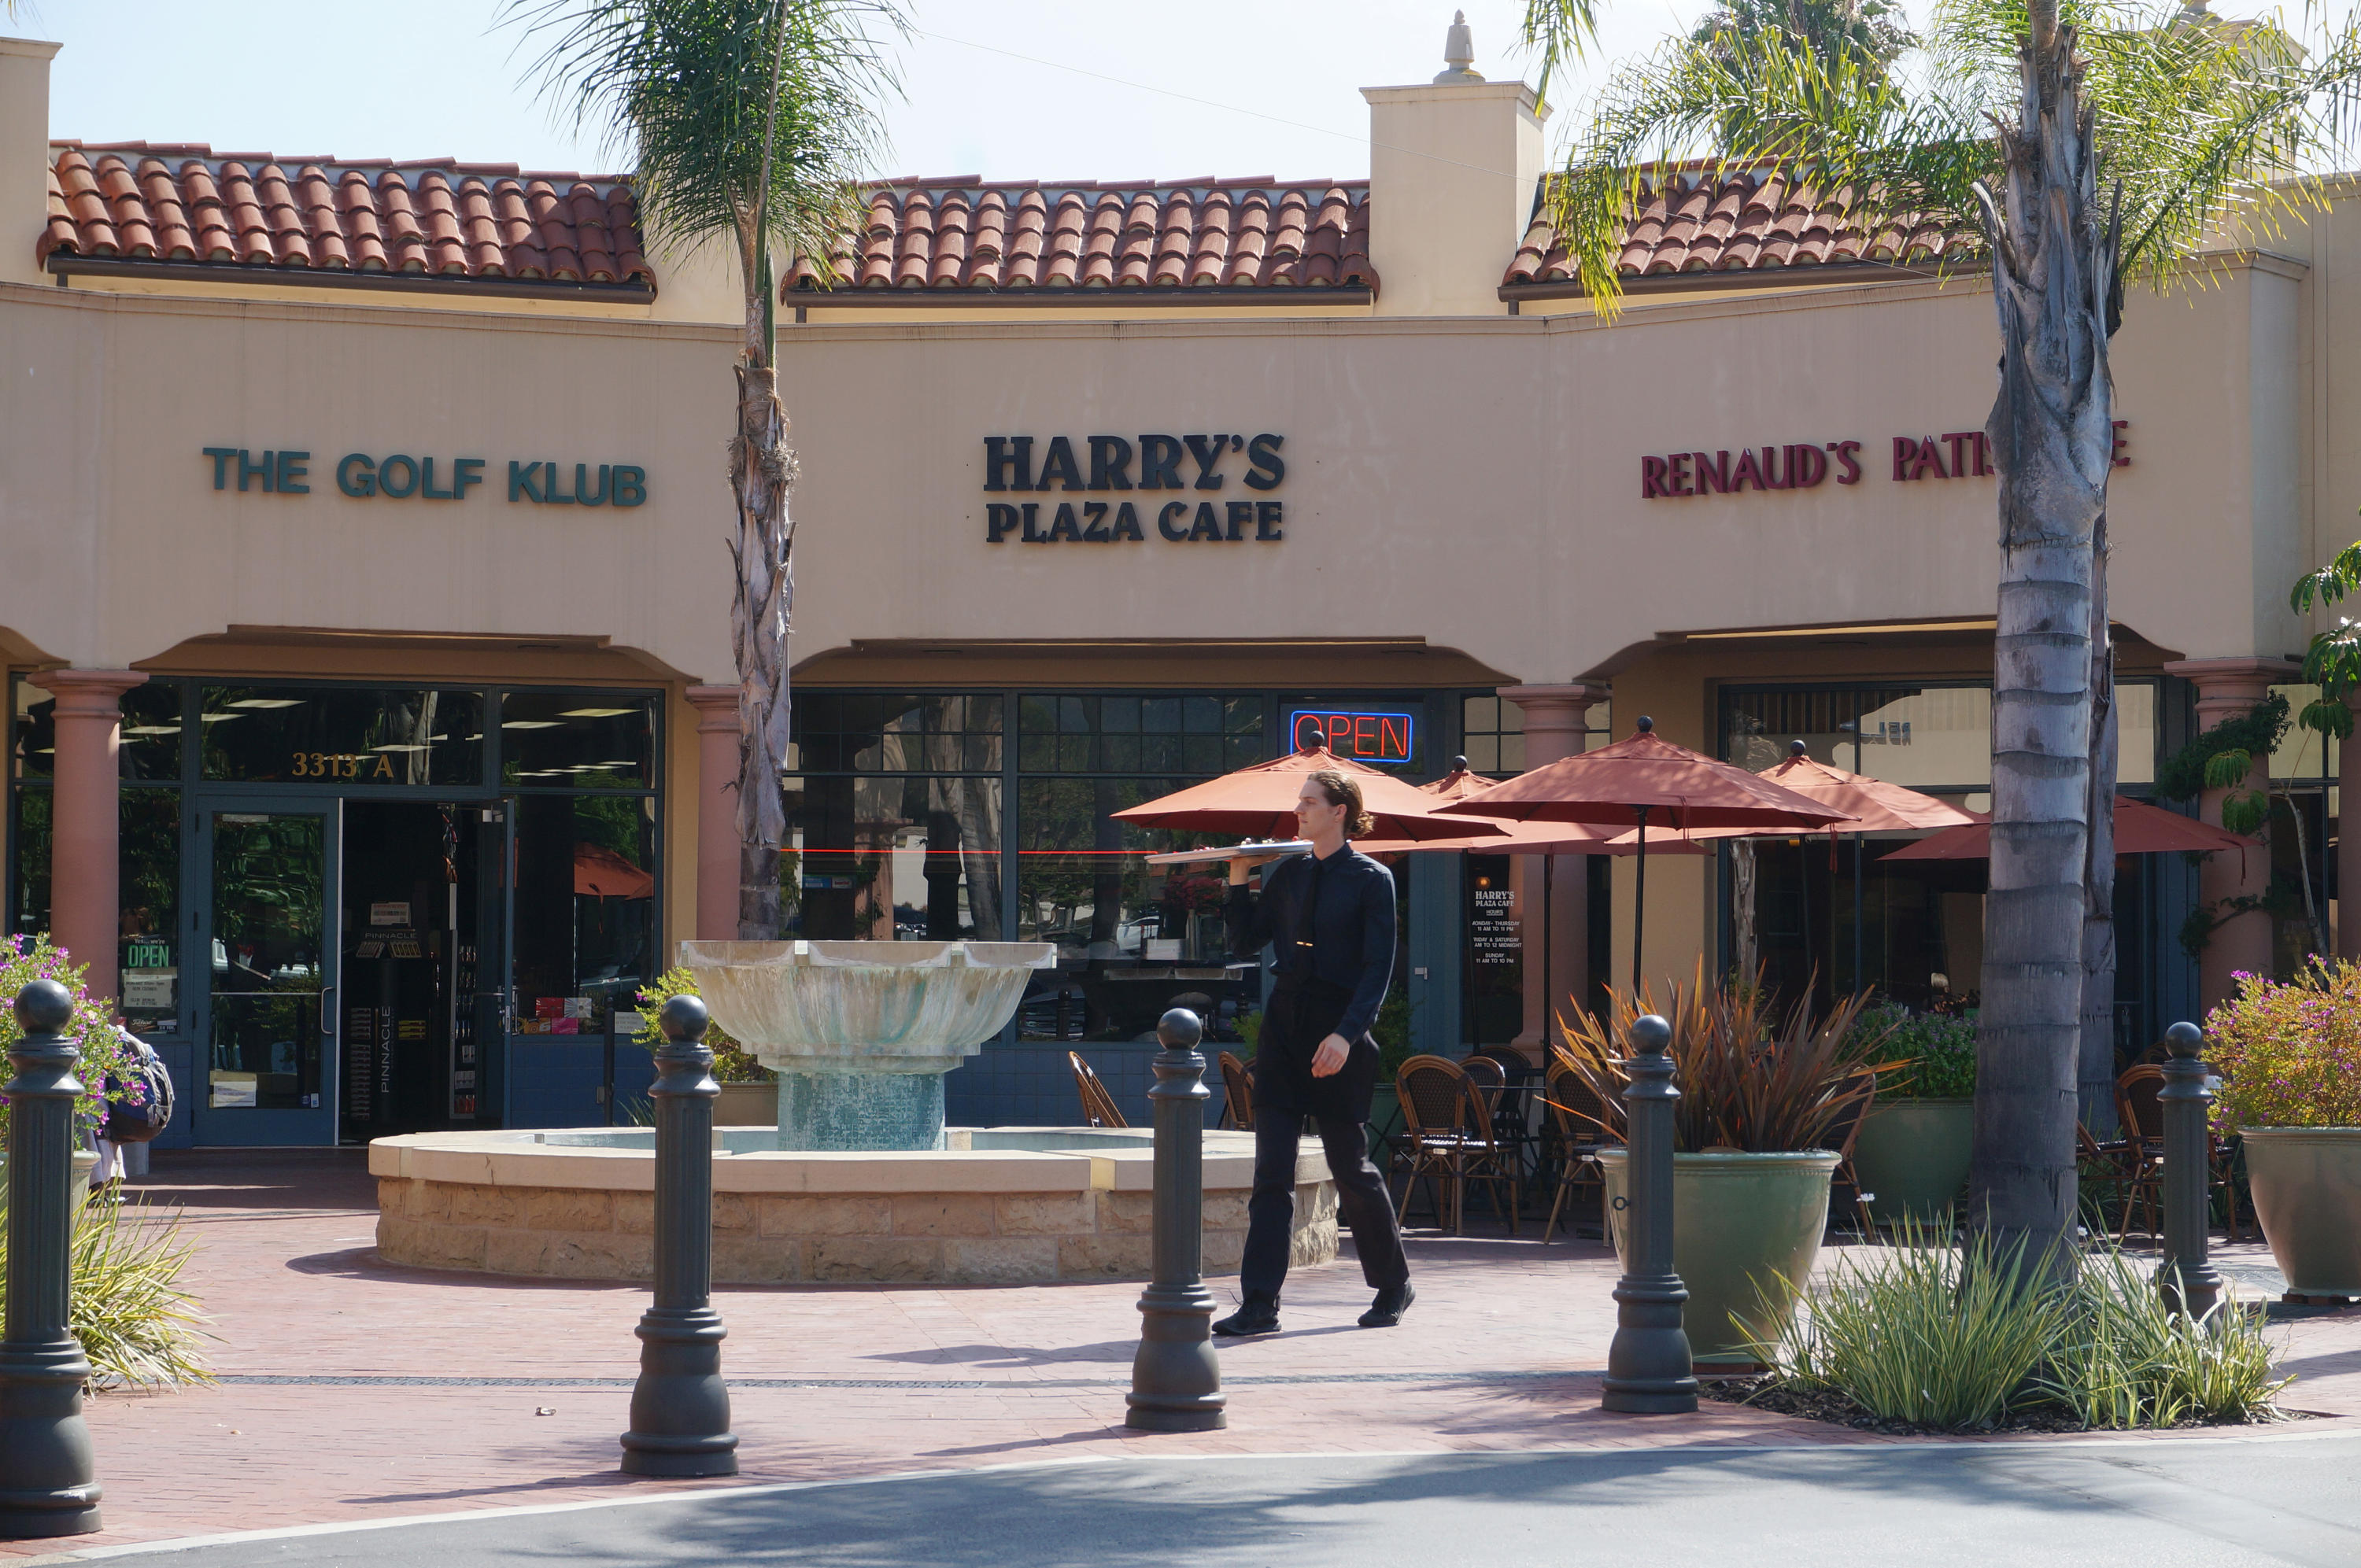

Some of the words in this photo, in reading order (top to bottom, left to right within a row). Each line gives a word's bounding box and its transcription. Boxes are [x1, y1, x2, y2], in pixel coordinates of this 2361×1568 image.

[203, 448, 310, 494] THE
[336, 453, 486, 500] GOLF
[508, 460, 647, 507] KLUB
[984, 434, 1285, 492] HARRY'S
[1641, 440, 1860, 500] RENAUD'S
[986, 501, 1144, 543] PLAZA
[1158, 501, 1282, 542] CAFE
[1295, 714, 1407, 757] OPEN
[291, 751, 357, 777] 3313
[372, 754, 394, 778] A
[1475, 891, 1515, 900] HARRY'S
[128, 945, 169, 968] OPEN
[381, 1005, 390, 1094] PINNACLE
